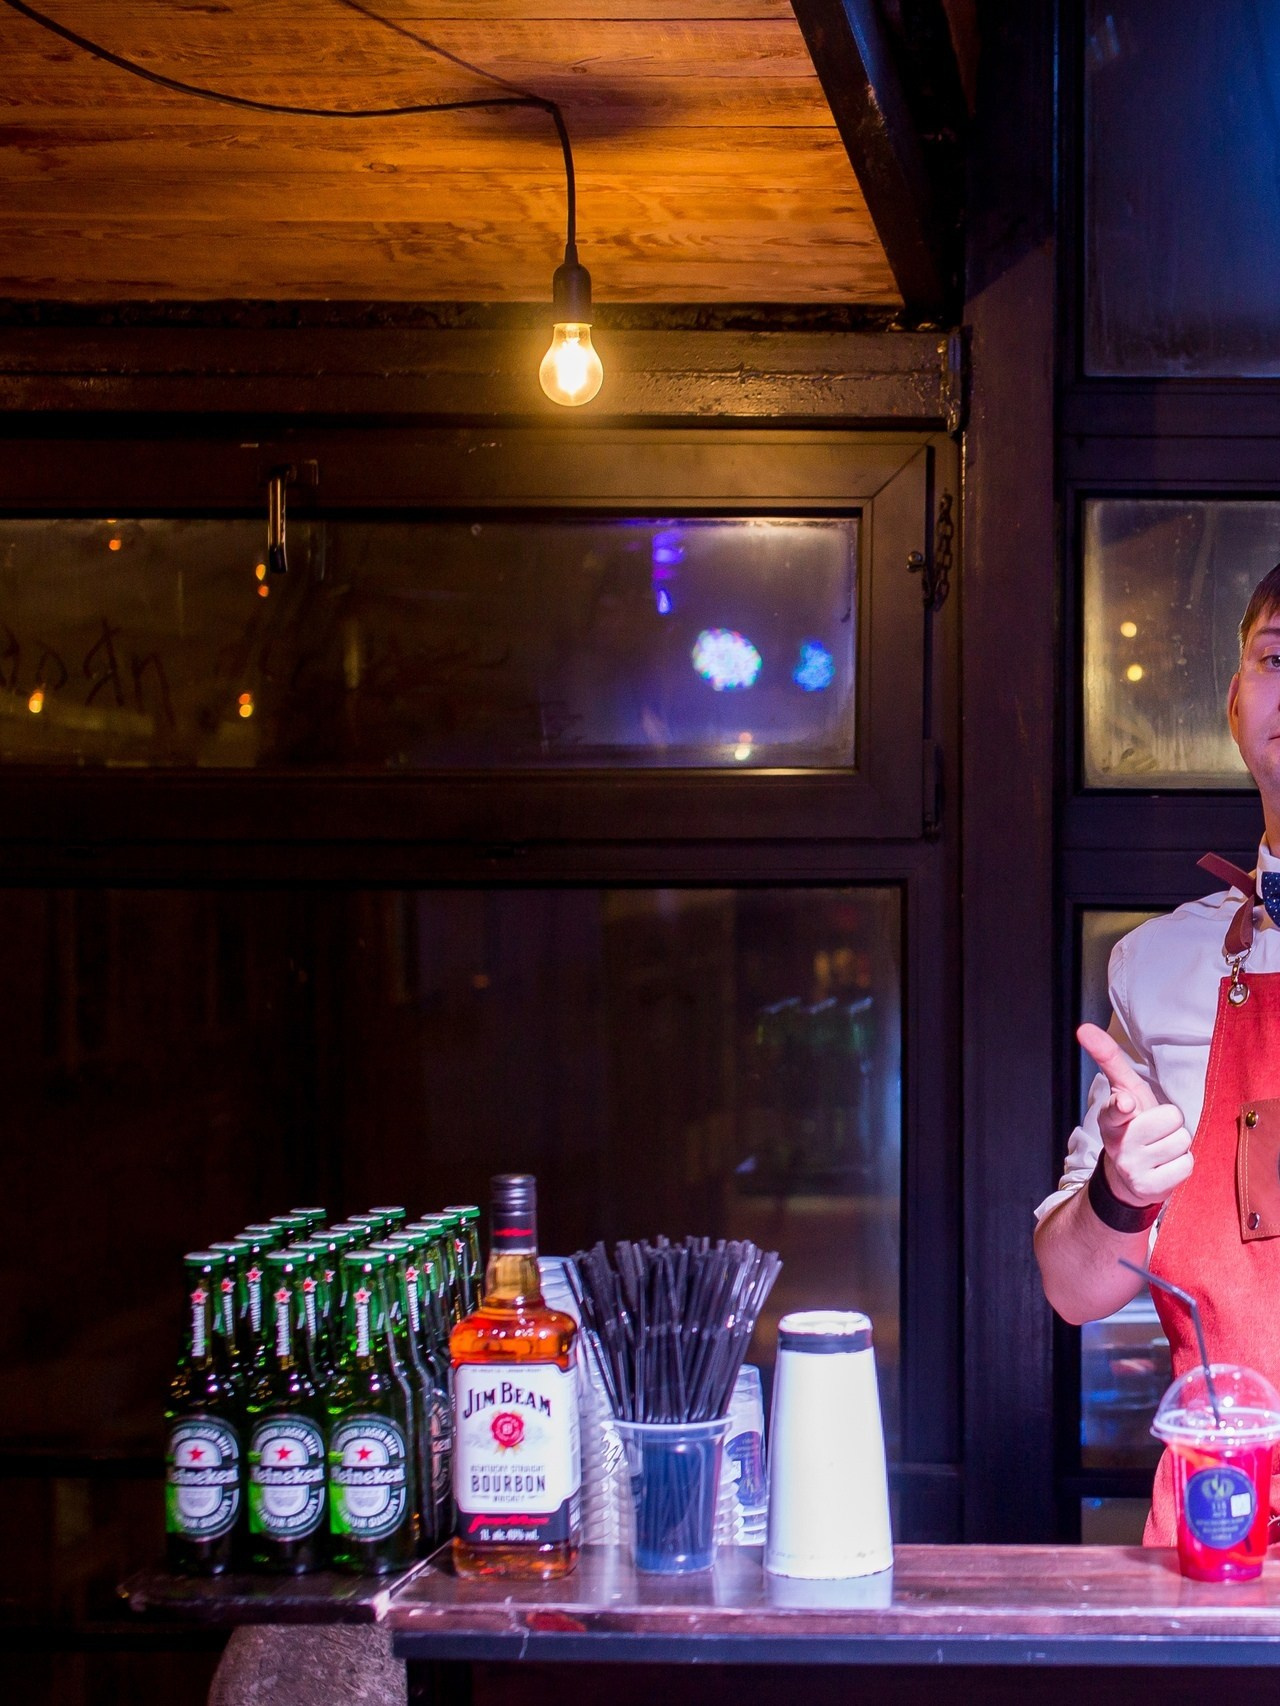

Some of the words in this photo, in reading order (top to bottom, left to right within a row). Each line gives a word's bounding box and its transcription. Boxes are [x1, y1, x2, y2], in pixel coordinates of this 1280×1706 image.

[276, 1303, 290, 1357] Heineken
[354, 1303, 370, 1357] Heineken
[463, 1388, 496, 1419] JIM
[501, 1382, 551, 1417] BEAM
[168, 1464, 240, 1485] eineken
[471, 1475, 546, 1493] BOURBON
